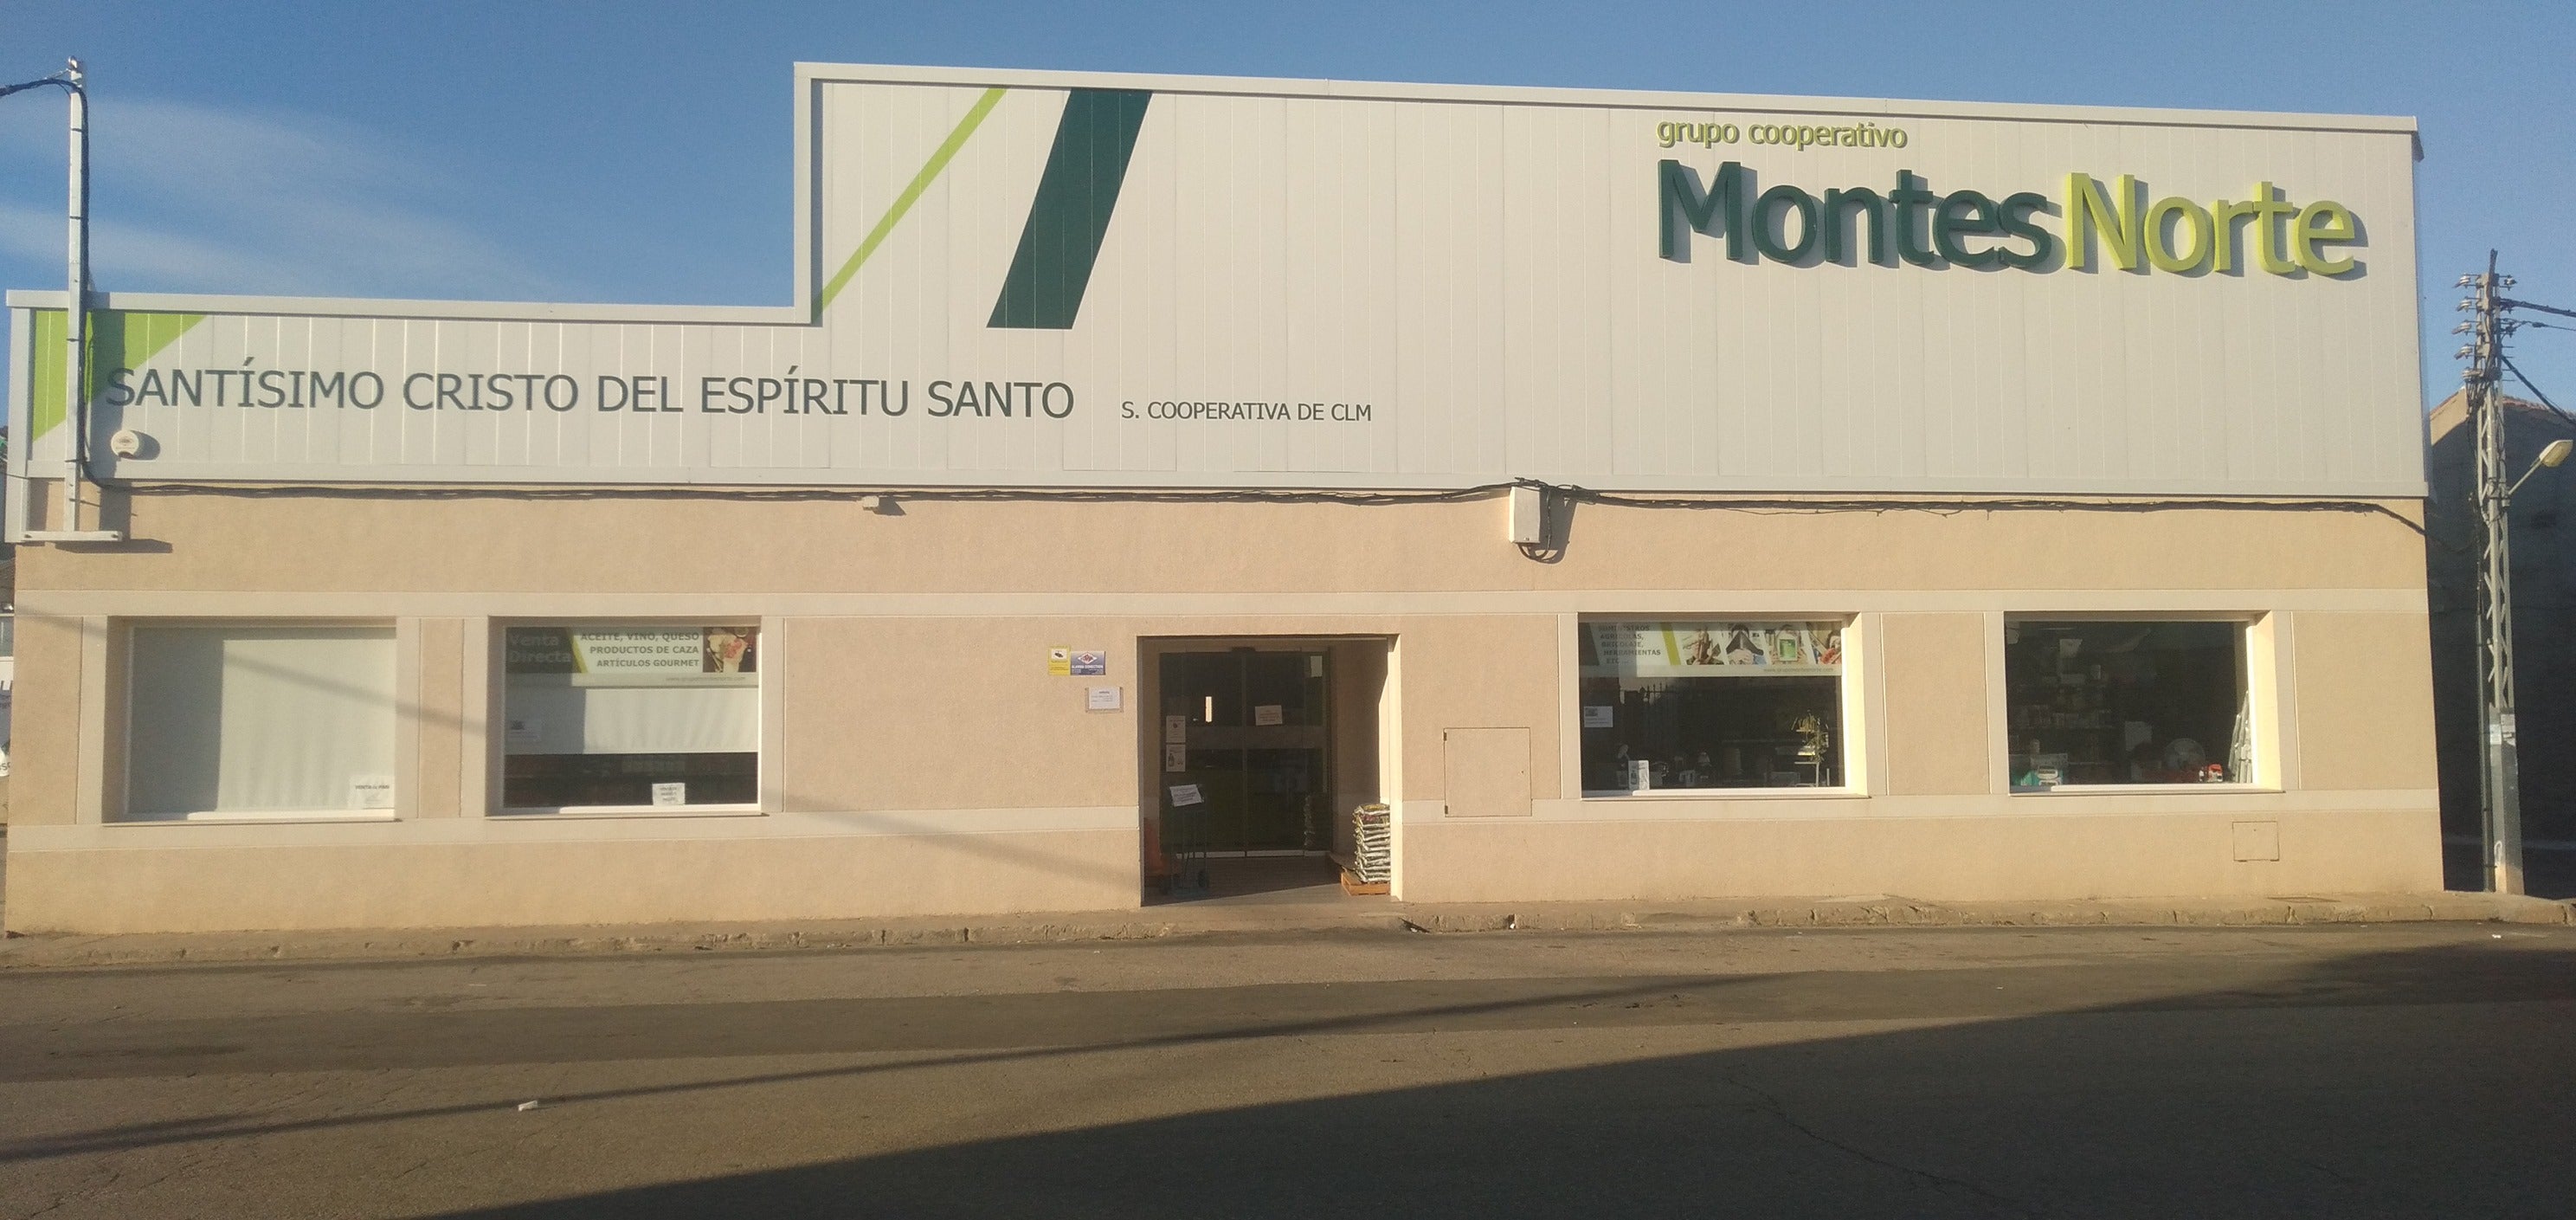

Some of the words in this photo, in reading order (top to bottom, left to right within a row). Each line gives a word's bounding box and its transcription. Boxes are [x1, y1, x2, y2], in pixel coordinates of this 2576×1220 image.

[1657, 120, 1740, 149] grupo
[1748, 121, 1908, 151] cooperativo
[105, 357, 385, 410] SANTÍSIMO
[402, 372, 579, 412] CRISTO
[597, 375, 684, 413] DEL
[700, 365, 909, 417] ESPÍRITU
[927, 380, 1075, 419] SANTO
[1121, 401, 1140, 419] S.
[1147, 401, 1291, 421] COOPERATIVA
[1298, 403, 1325, 421] DE
[1330, 403, 1372, 422] CLM
[580, 632, 623, 642] ACEITE,
[627, 632, 659, 642] VINO,
[661, 632, 699, 642] QUESO
[589, 646, 654, 655] PRODUCTOS
[596, 658, 651, 667] ARTÍCULOS
